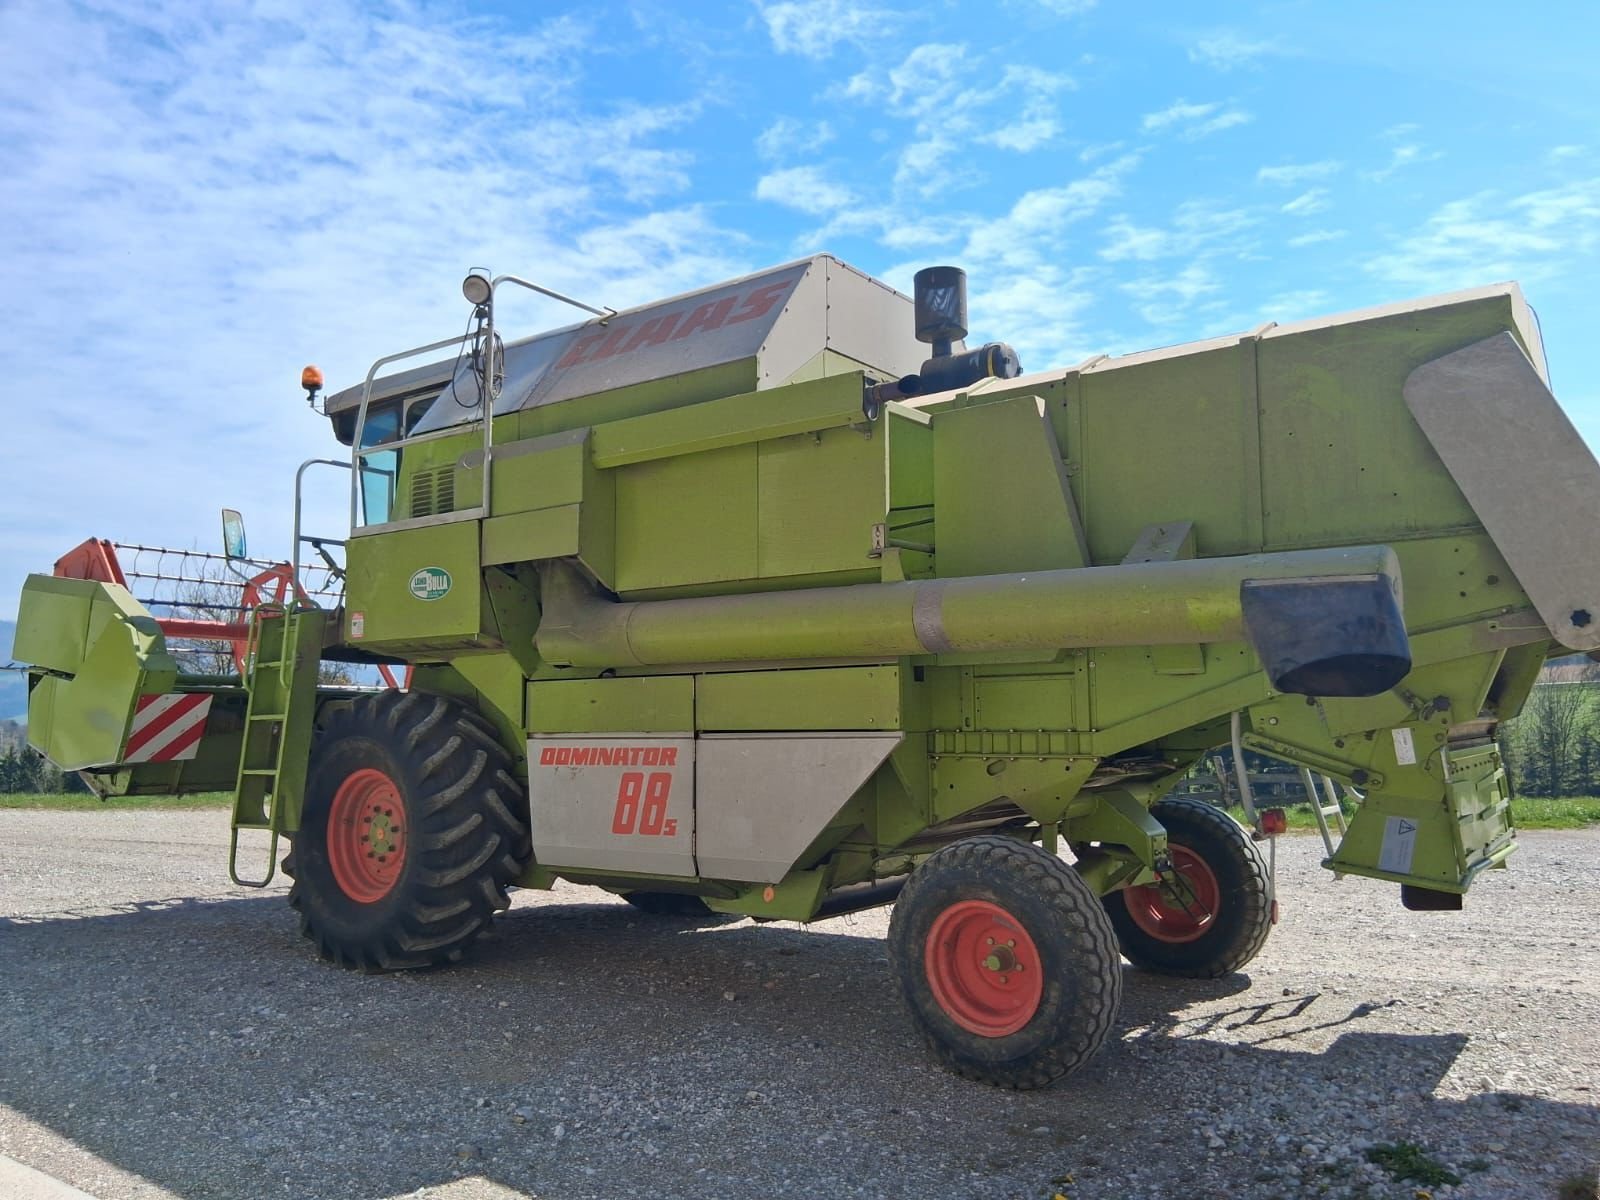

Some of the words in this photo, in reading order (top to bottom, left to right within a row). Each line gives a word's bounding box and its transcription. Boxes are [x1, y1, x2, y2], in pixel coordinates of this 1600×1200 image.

[554, 280, 794, 369] CLAAS
[426, 573, 448, 591] BULLA
[540, 747, 677, 766] DOMINATOR
